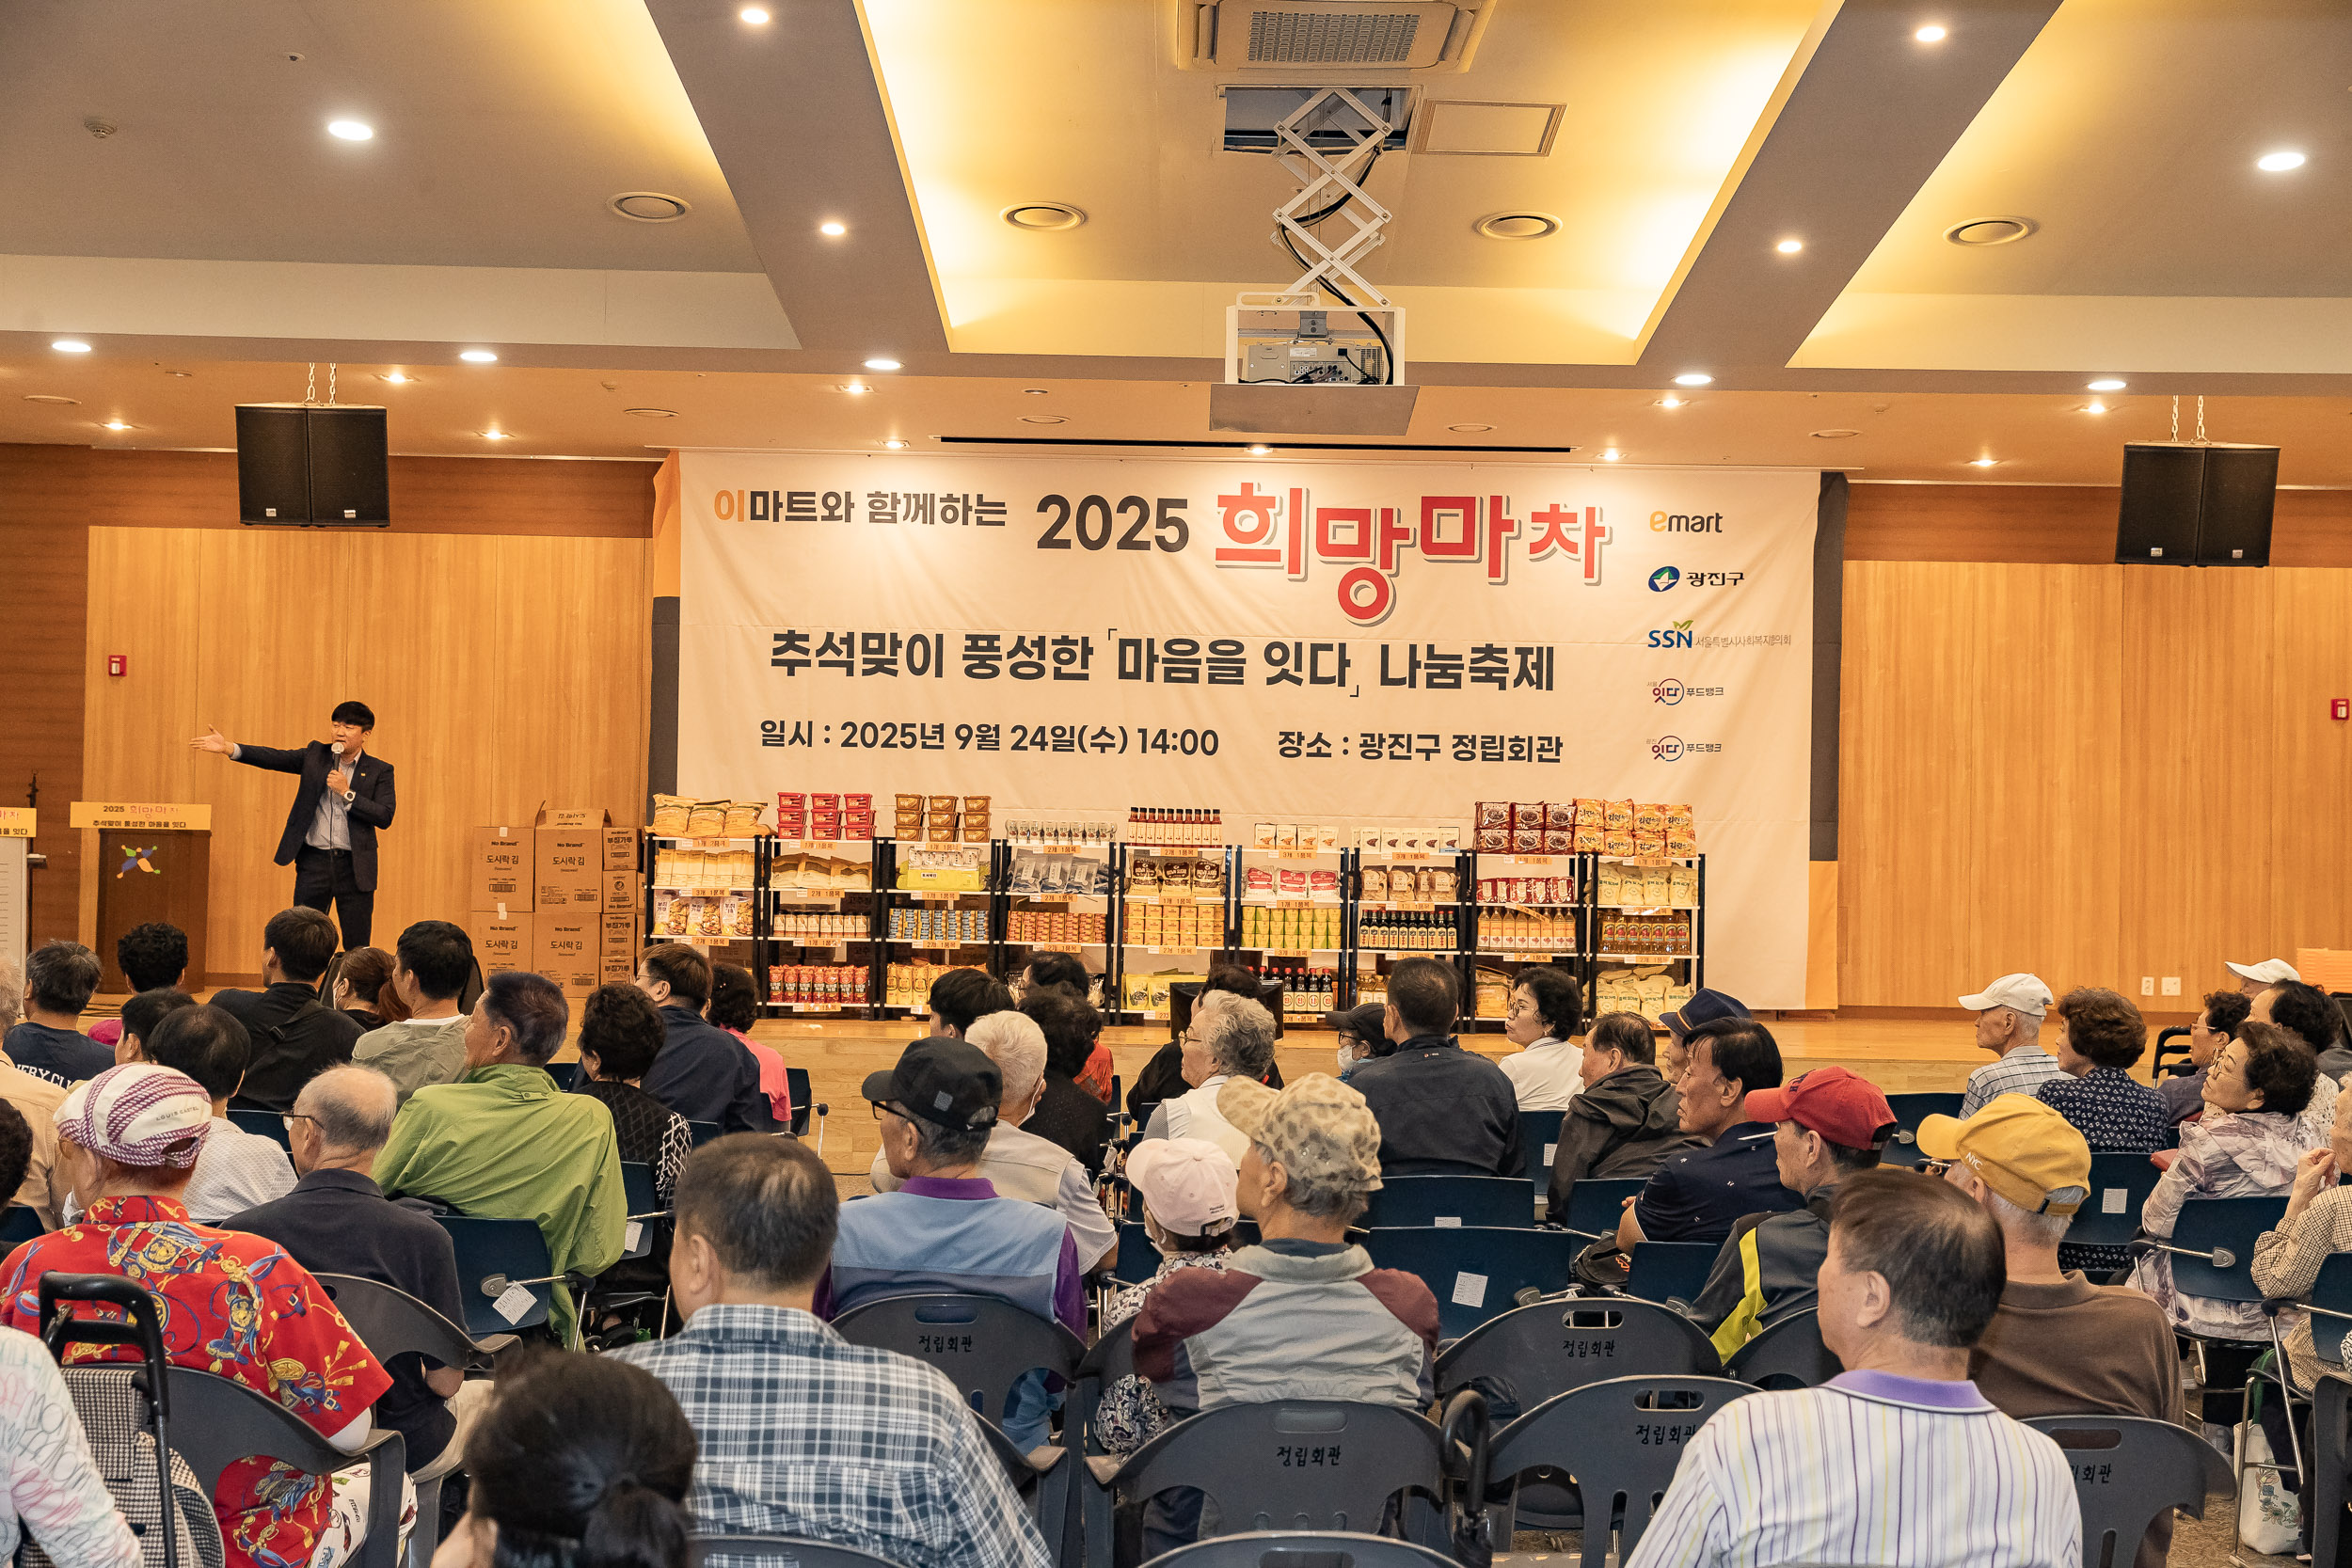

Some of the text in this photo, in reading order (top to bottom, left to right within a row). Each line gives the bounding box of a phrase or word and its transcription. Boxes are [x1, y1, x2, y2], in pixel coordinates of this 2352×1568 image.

[1649, 511, 1724, 533] emart
[714, 482, 1612, 625] 이마트와 함께하는 2025 희망마차
[1686, 572, 1745, 587] 광진구
[1647, 630, 1692, 648] SSN
[771, 630, 944, 678] 추석맞이
[961, 632, 1093, 681] 풍성한
[1381, 643, 1555, 691] 나눔축제
[1652, 688, 1679, 704] 잇다
[1686, 687, 1724, 697] 푸드뱅크
[759, 721, 814, 748] 일시
[840, 722, 946, 752] 2025년
[954, 724, 1001, 752] 9월
[1010, 725, 1129, 755] 24일(수)
[1137, 728, 1219, 755] 14:00
[1277, 731, 1334, 759] 장소
[1359, 732, 1440, 761] 광진구
[1452, 735, 1564, 763] 정립회관
[1651, 744, 1679, 760] 잇다
[1686, 743, 1722, 752] 푸드뱅크
[486, 855, 519, 864] 도시락 김
[552, 857, 585, 866] 도시락 김
[485, 941, 518, 949] 도시락 김
[550, 941, 583, 949] 도시락 김
[155, 1111, 179, 1121] LOUIS
[1965, 1151, 1983, 1171] NYC
[918, 1335, 973, 1354] 정립회관
[1563, 1339, 1615, 1358] 정립회관
[1277, 1445, 1342, 1467] 정립회관
[2070, 1463, 2112, 1484] 회관
